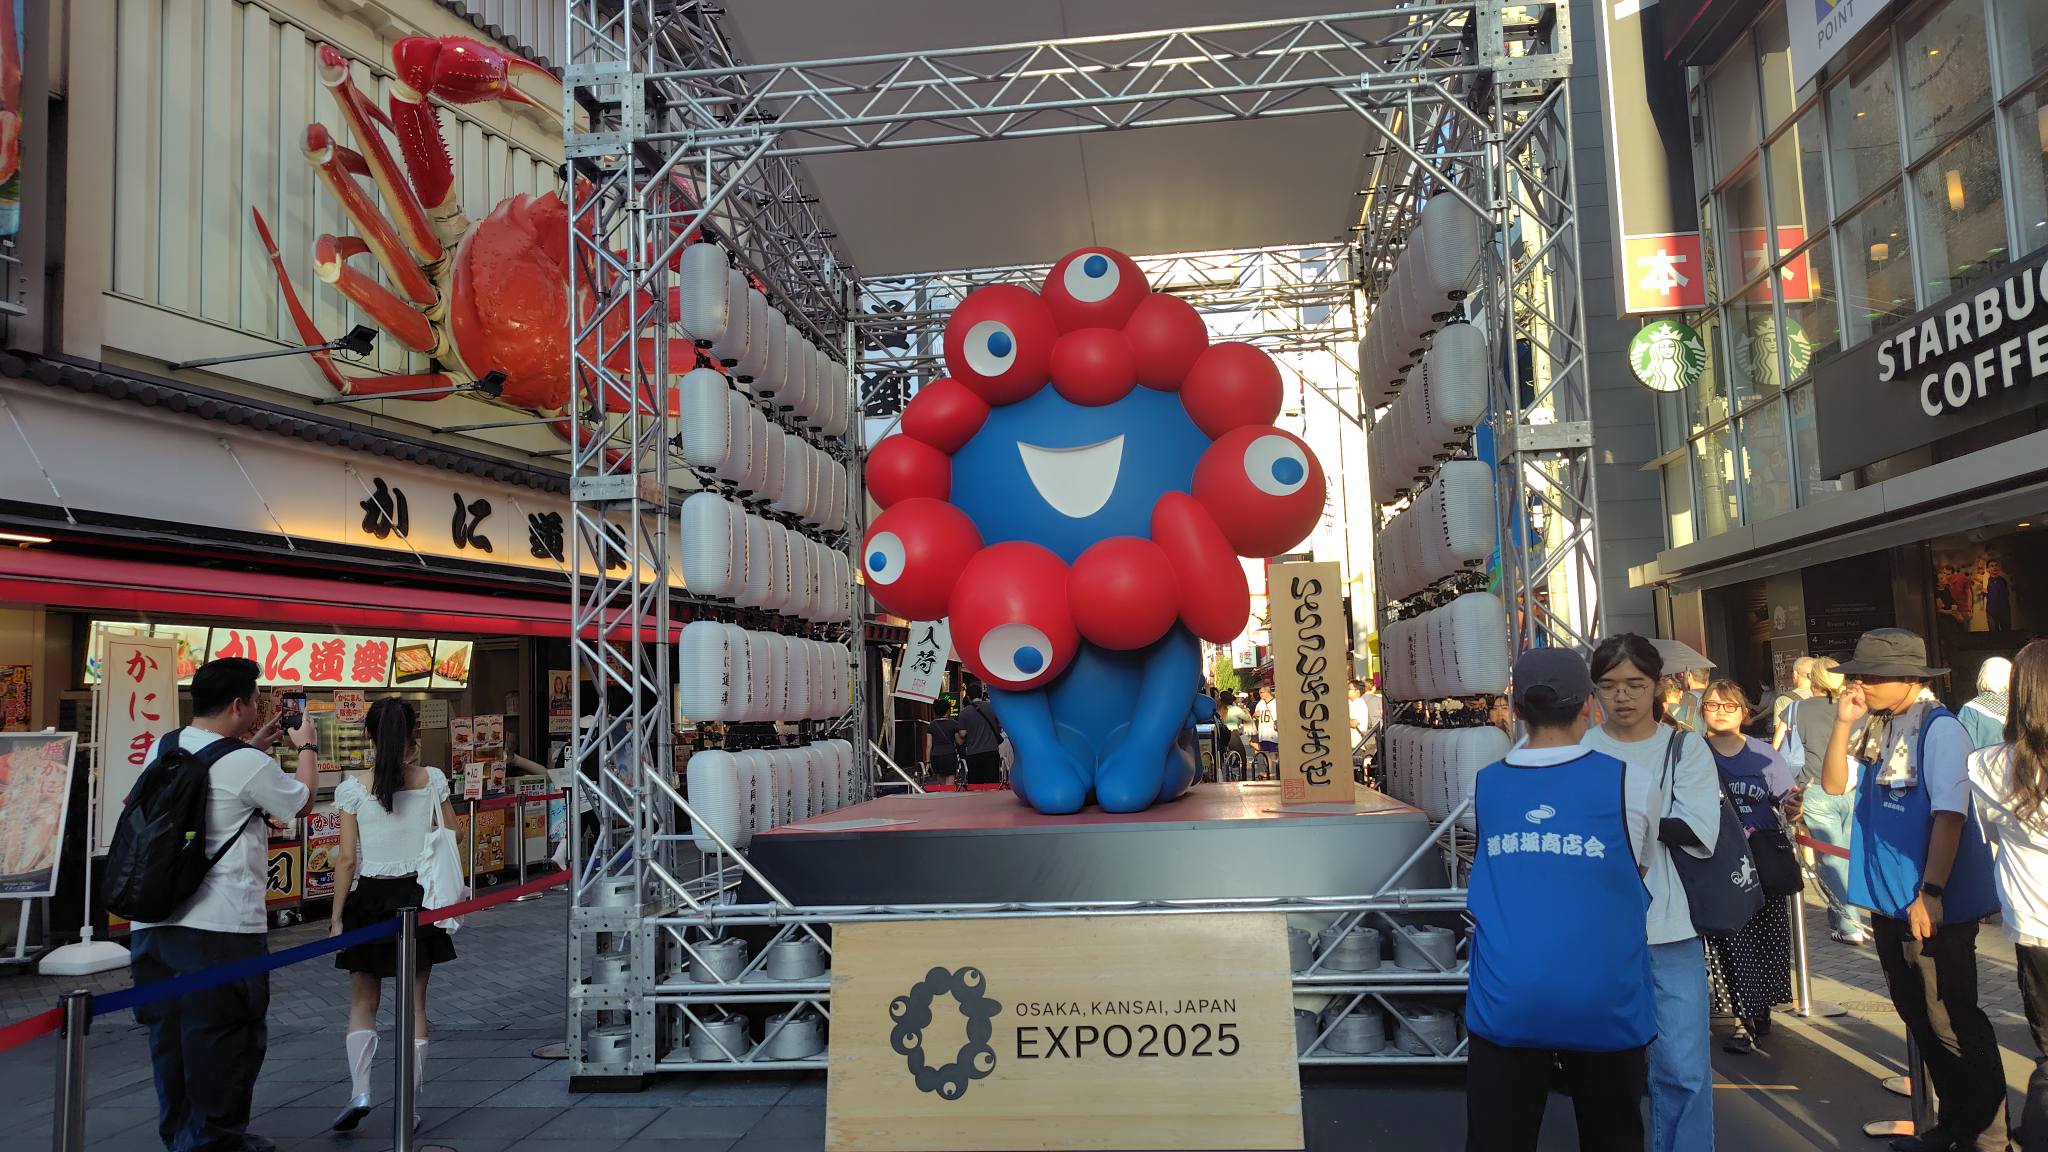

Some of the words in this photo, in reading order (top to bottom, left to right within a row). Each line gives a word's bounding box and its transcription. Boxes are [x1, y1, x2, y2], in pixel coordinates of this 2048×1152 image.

[1817, 0, 1854, 49] POINT
[1636, 248, 1688, 296] 本
[123, 649, 160, 806] かにま
[1260, 709, 1270, 723] 16
[1016, 1002, 1087, 1017] OSAKA,
[1091, 1000, 1169, 1016] KANSAI,
[1173, 998, 1237, 1014] JAPAN
[1016, 1022, 1241, 1060] EXPO2025
